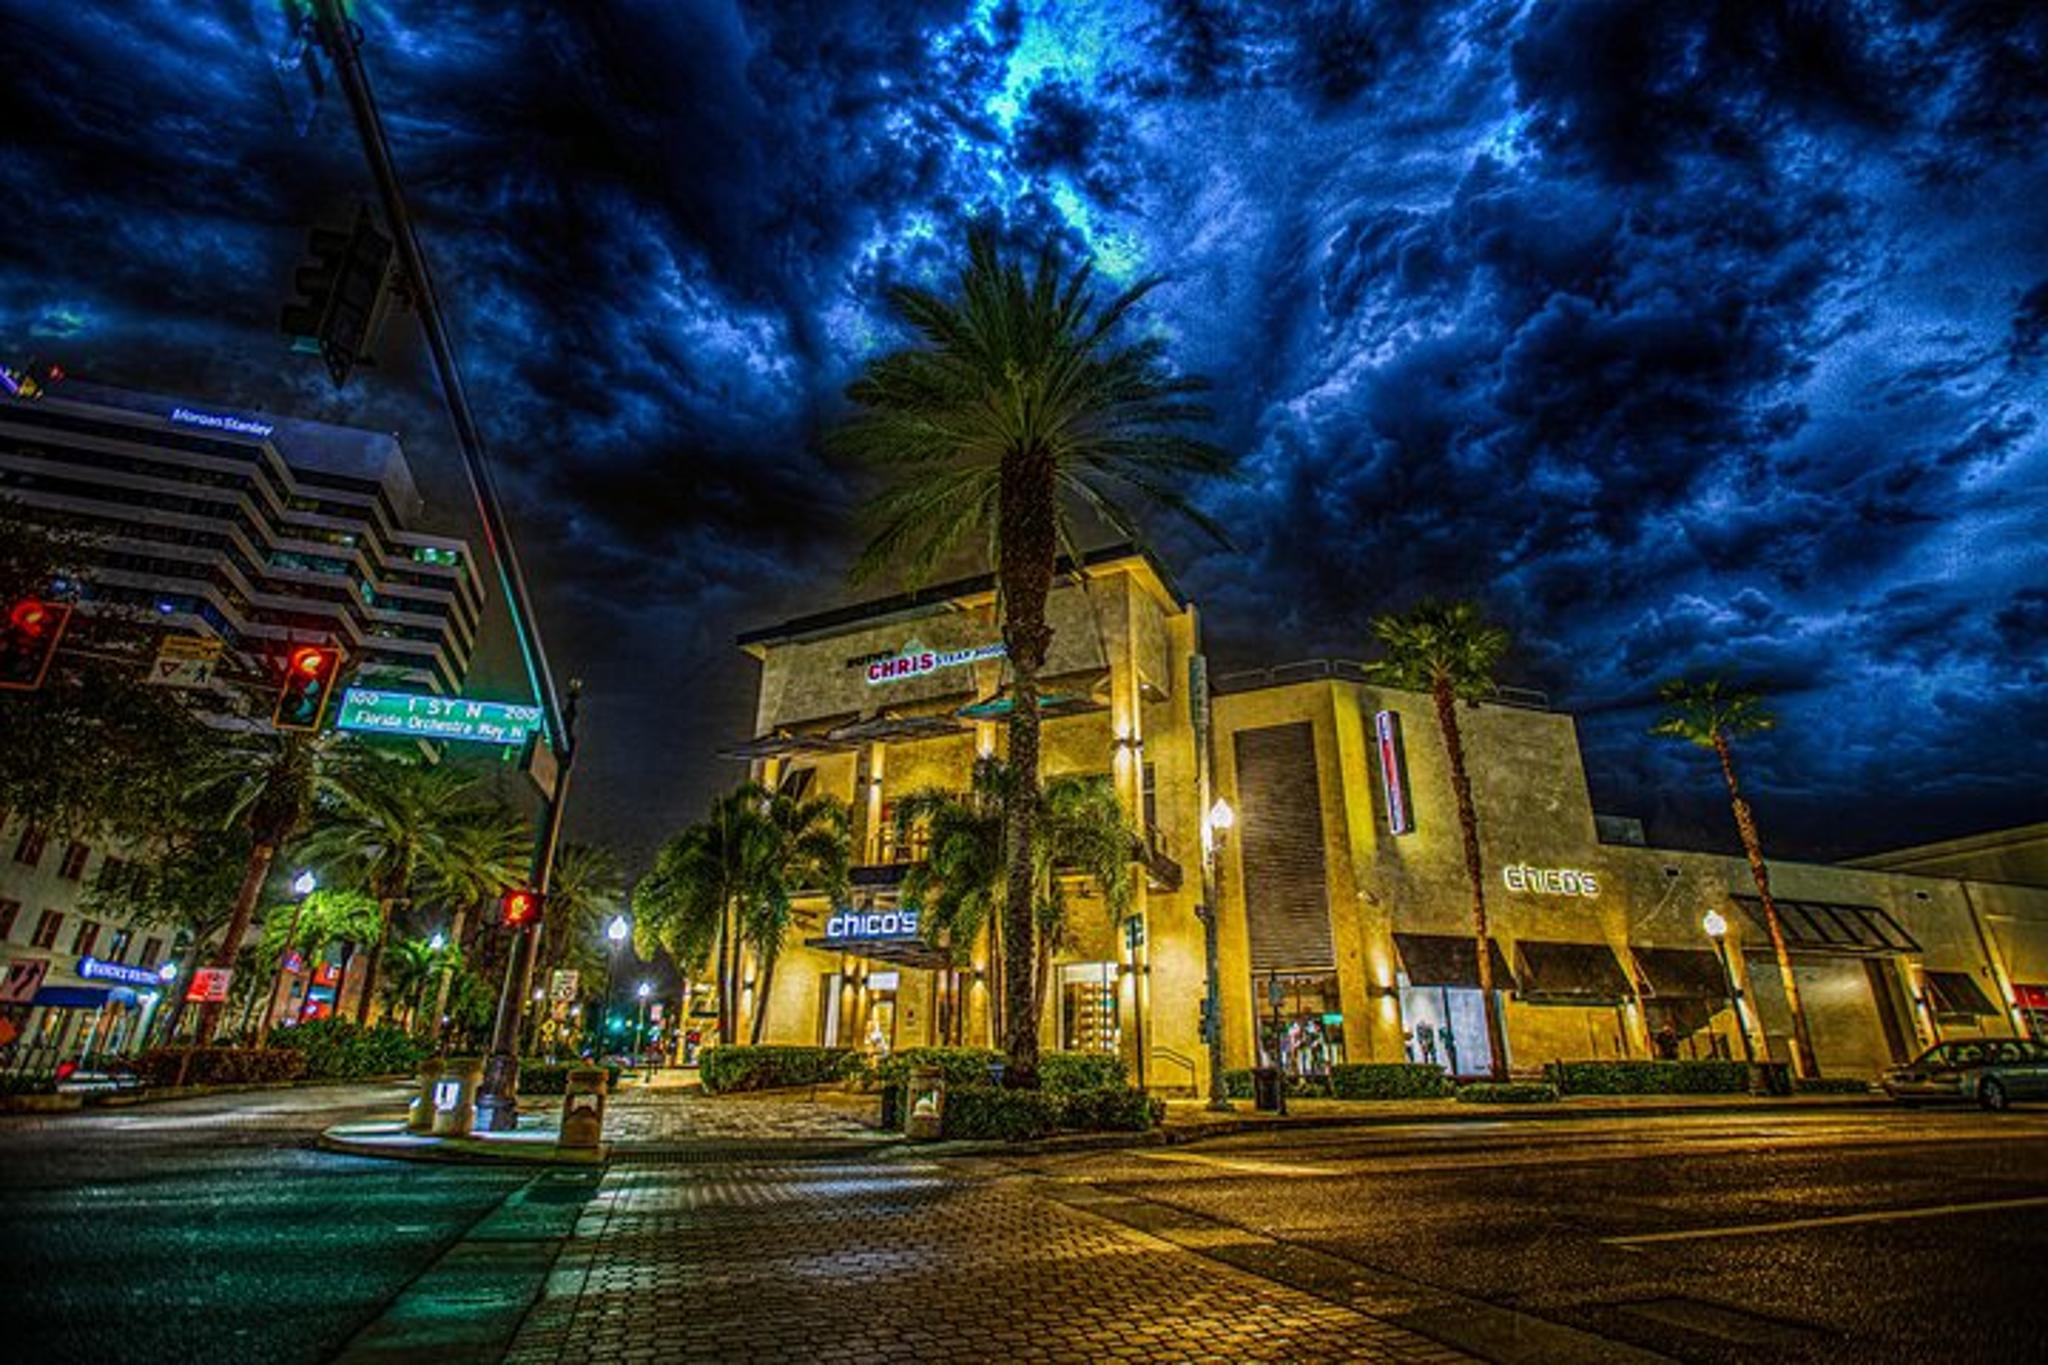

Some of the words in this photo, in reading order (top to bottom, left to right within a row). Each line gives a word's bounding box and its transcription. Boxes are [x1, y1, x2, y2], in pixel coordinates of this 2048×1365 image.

[868, 652, 934, 681] CHRIS
[427, 699, 455, 716] ST
[466, 703, 482, 718] N
[355, 710, 402, 727] Florida
[409, 715, 473, 735] Orchestra
[827, 909, 918, 936] chico's
